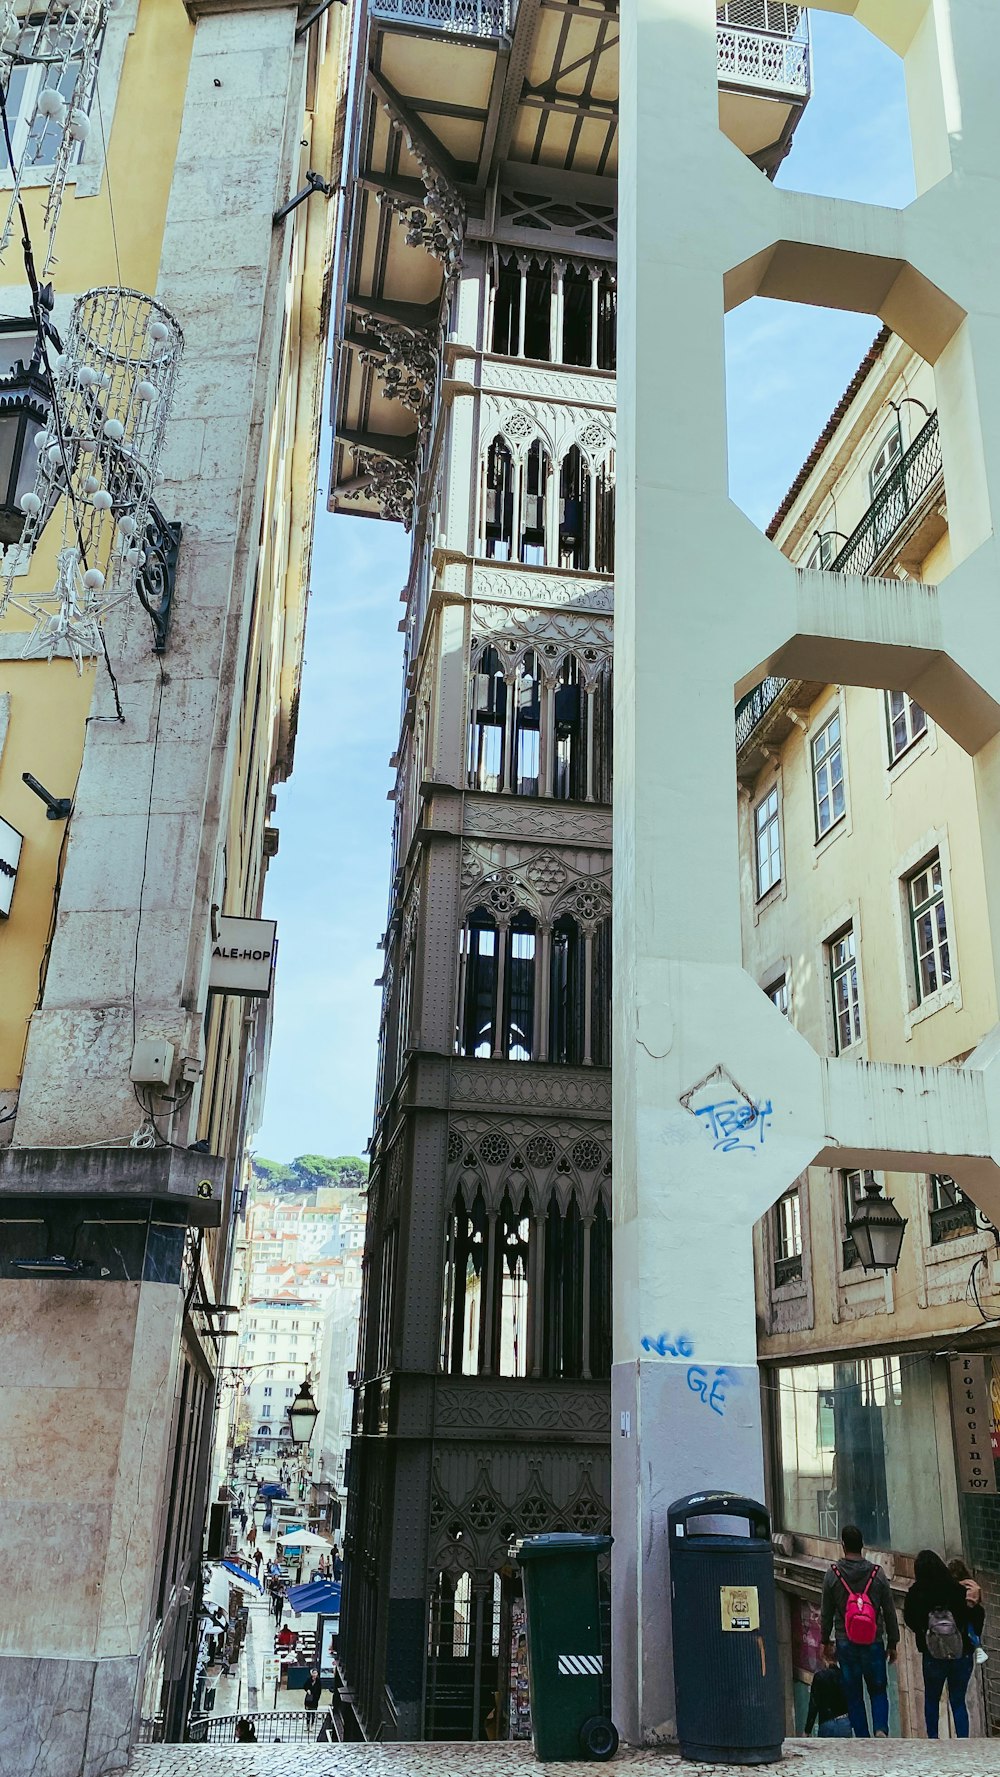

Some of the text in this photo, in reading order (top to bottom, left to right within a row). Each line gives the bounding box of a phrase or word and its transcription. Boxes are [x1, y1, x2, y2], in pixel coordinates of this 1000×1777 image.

[212, 946, 270, 961] ALE-HOP
[962, 1359, 982, 1476] fotocine
[968, 1479, 989, 1488] 107
